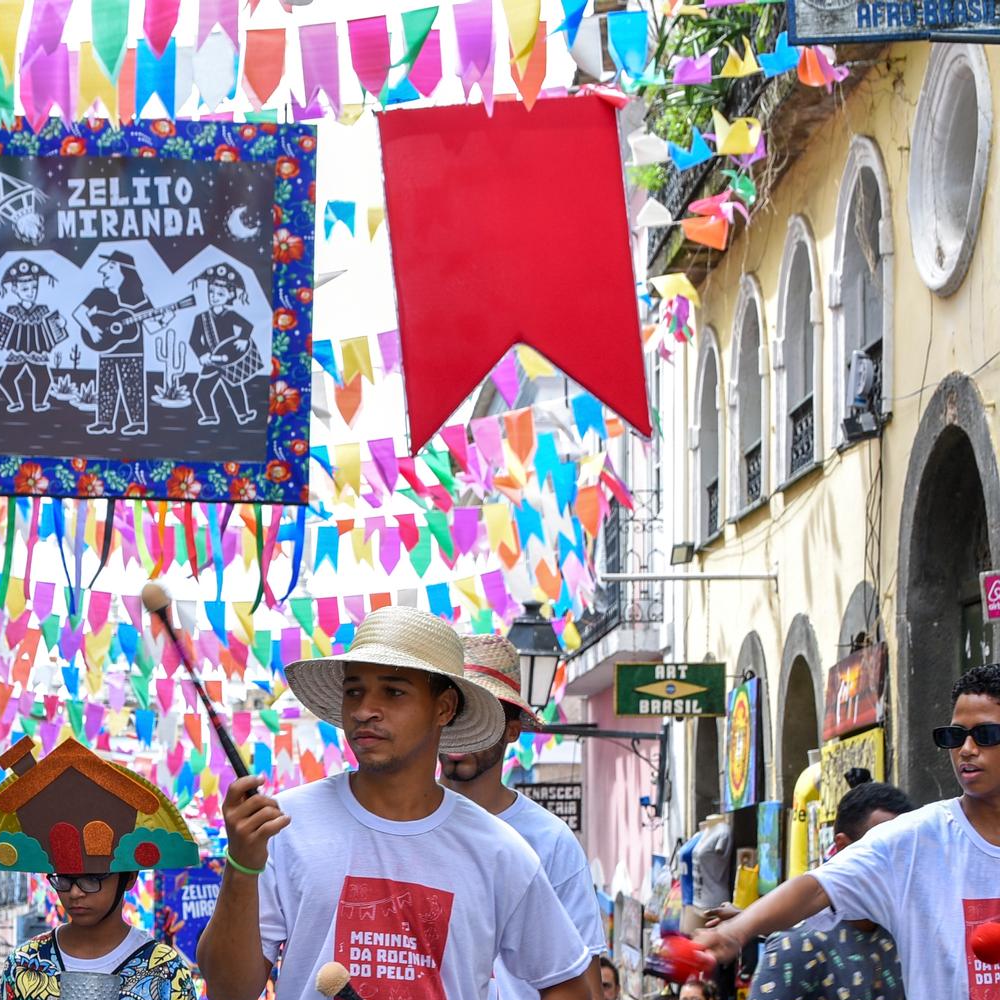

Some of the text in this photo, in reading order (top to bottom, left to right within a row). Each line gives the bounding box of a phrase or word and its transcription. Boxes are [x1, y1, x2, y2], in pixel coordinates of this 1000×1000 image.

[67, 176, 193, 207] ZELITO
[57, 207, 205, 239] MIRANDA
[655, 665, 688, 679] ART
[639, 699, 702, 714] BRASIL
[351, 931, 417, 950] MENINOS
[350, 947, 372, 961] DA
[350, 964, 416, 981] DO PELÔ
[976, 973, 993, 984] DO
